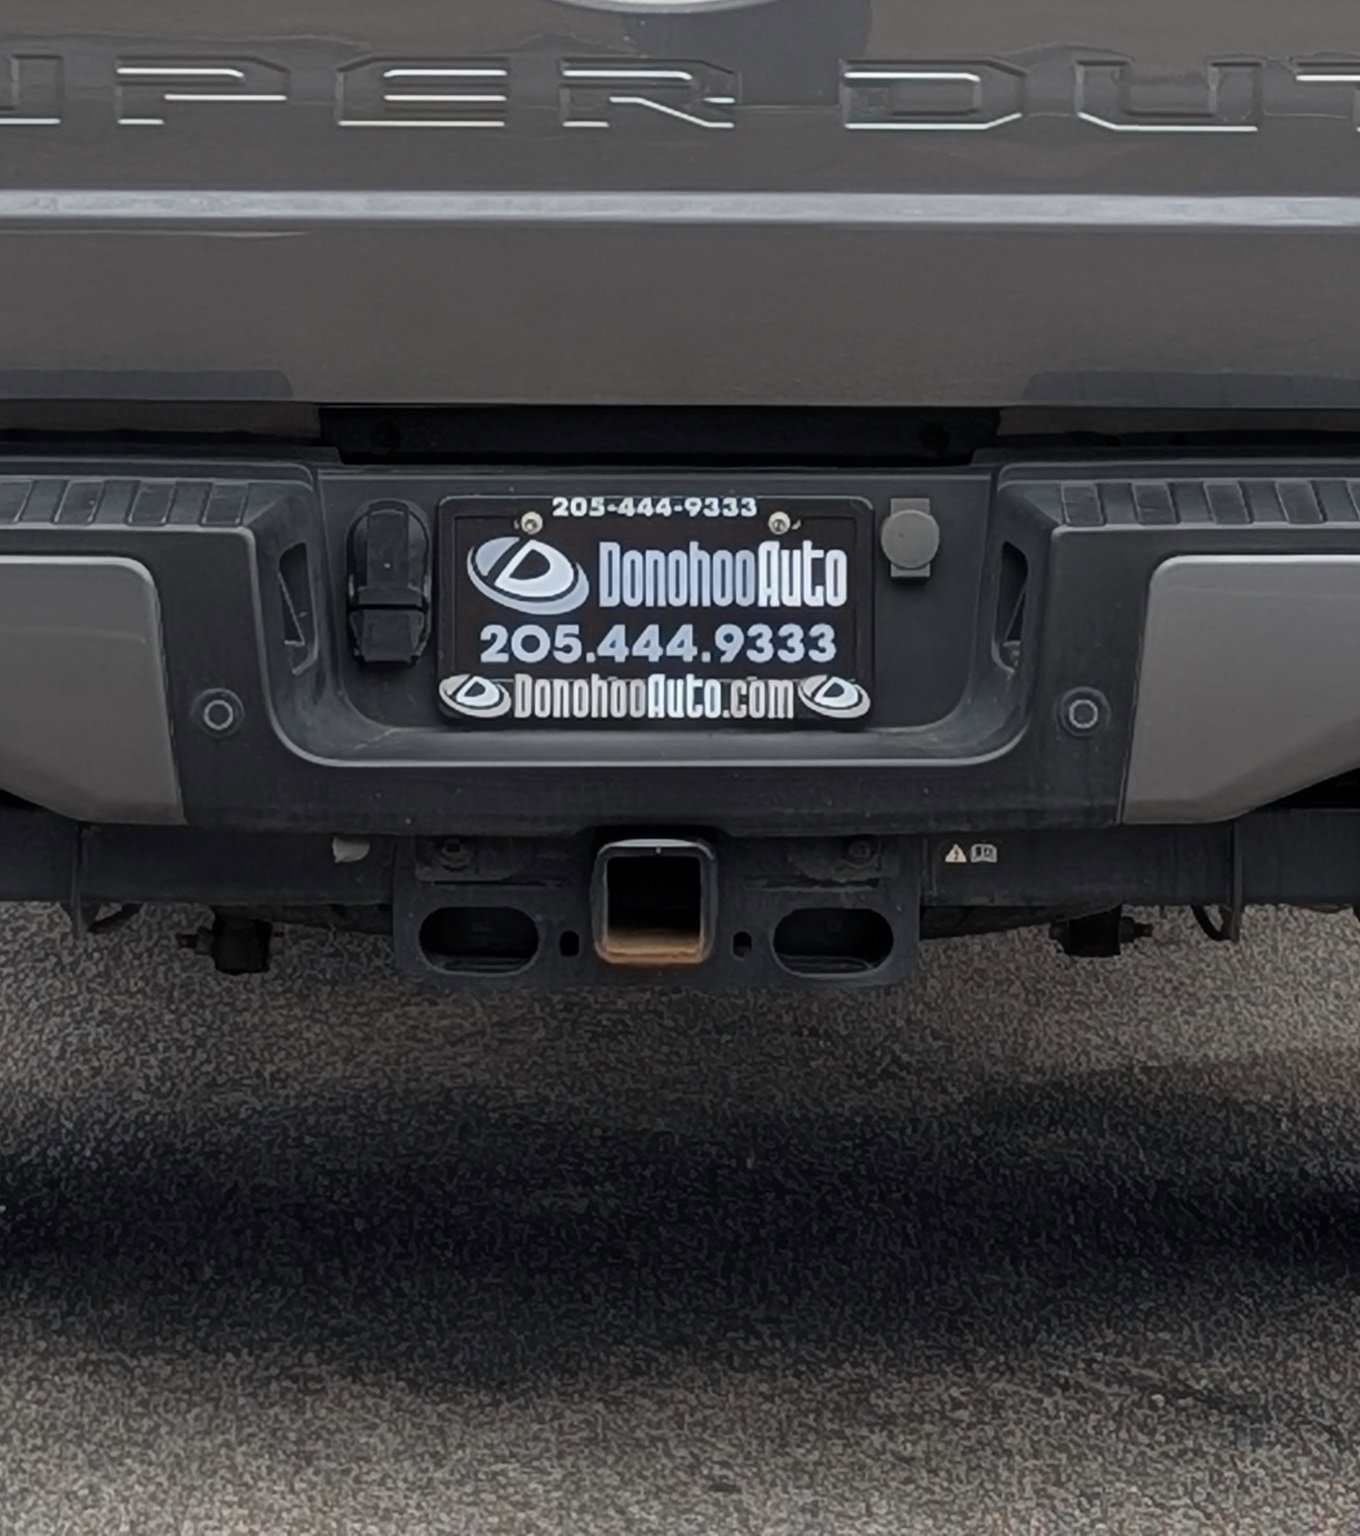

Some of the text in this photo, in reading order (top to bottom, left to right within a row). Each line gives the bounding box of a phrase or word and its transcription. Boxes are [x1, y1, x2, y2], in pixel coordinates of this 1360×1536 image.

[552, 497, 758, 517] 205-444-9333
[599, 540, 848, 608] DonohooAuto
[480, 623, 836, 663] 205.444.9333
[513, 673, 794, 719] DonohooAuto.com
